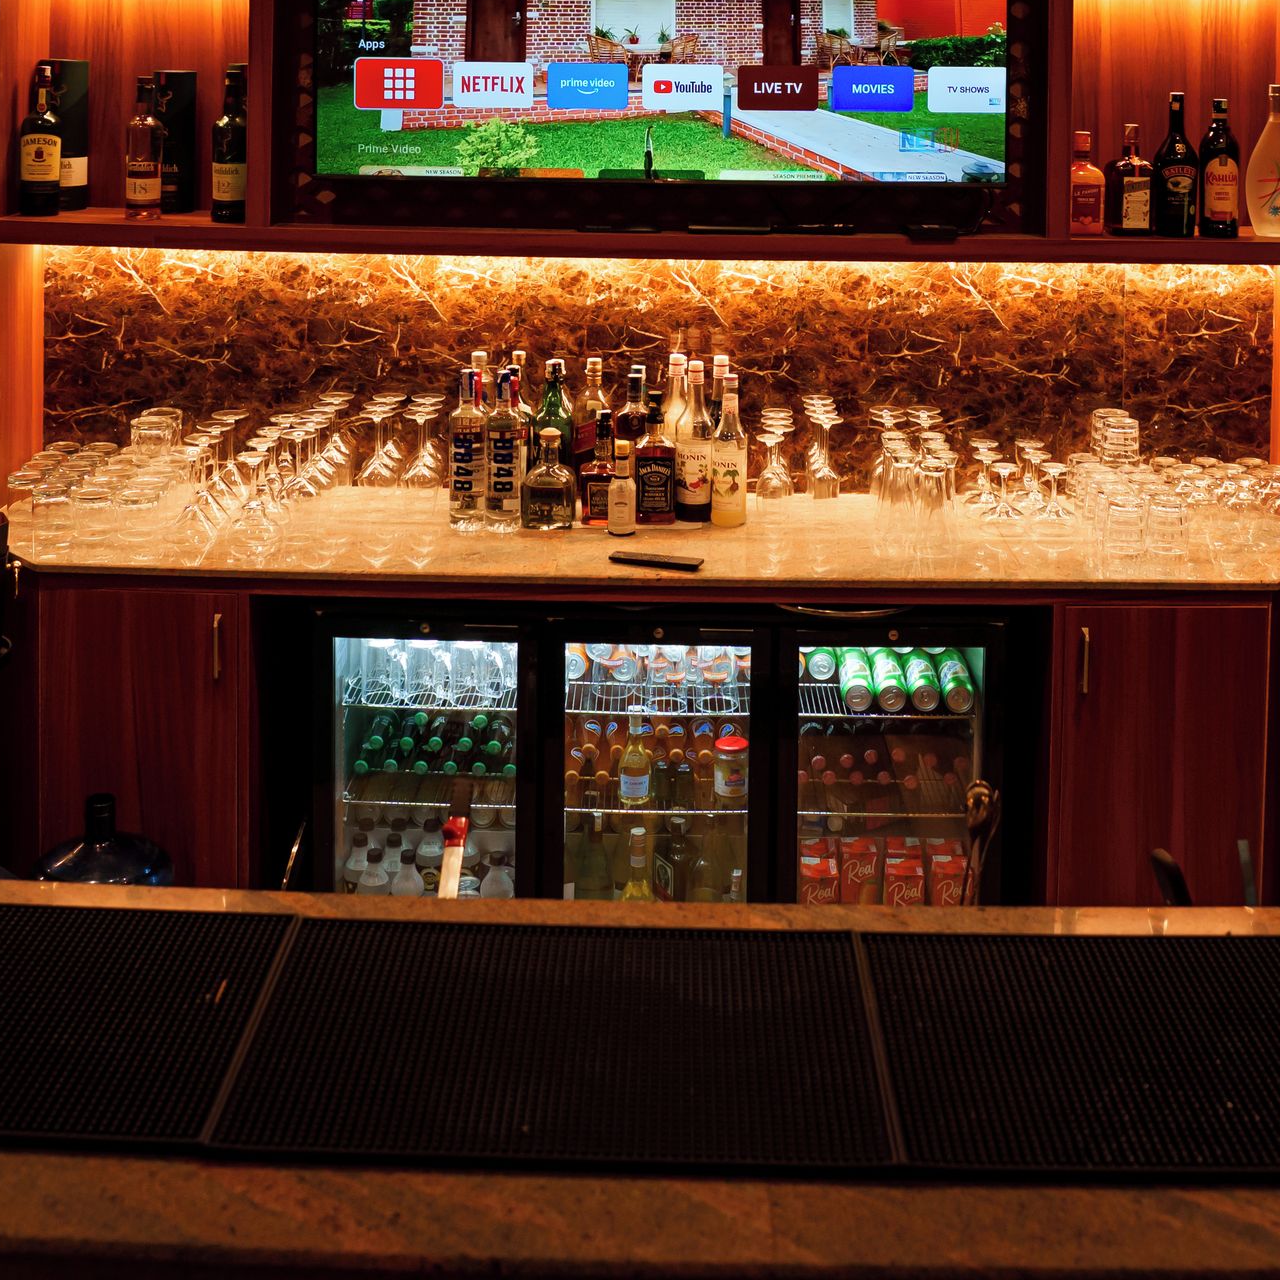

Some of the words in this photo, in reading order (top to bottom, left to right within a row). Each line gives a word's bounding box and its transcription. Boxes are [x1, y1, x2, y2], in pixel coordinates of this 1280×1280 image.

[358, 38, 385, 51] Apps
[461, 75, 525, 95] NETFLIX
[560, 77, 587, 89] prime
[588, 77, 615, 88] video
[674, 81, 712, 94] YouTube
[753, 81, 782, 94] LIVE
[784, 82, 803, 94] TV
[851, 83, 895, 95] MOVIES
[946, 85, 958, 94] TV
[959, 86, 990, 94] SHOWS
[22, 137, 58, 148] JAMESON
[357, 143, 389, 154] Prime
[390, 144, 422, 154] Video
[677, 451, 707, 461] MONIN
[493, 438, 514, 493] 8848
[638, 464, 652, 476] JACK
[843, 855, 878, 885] Real
[802, 880, 838, 905] Real
[888, 879, 924, 907] Real
